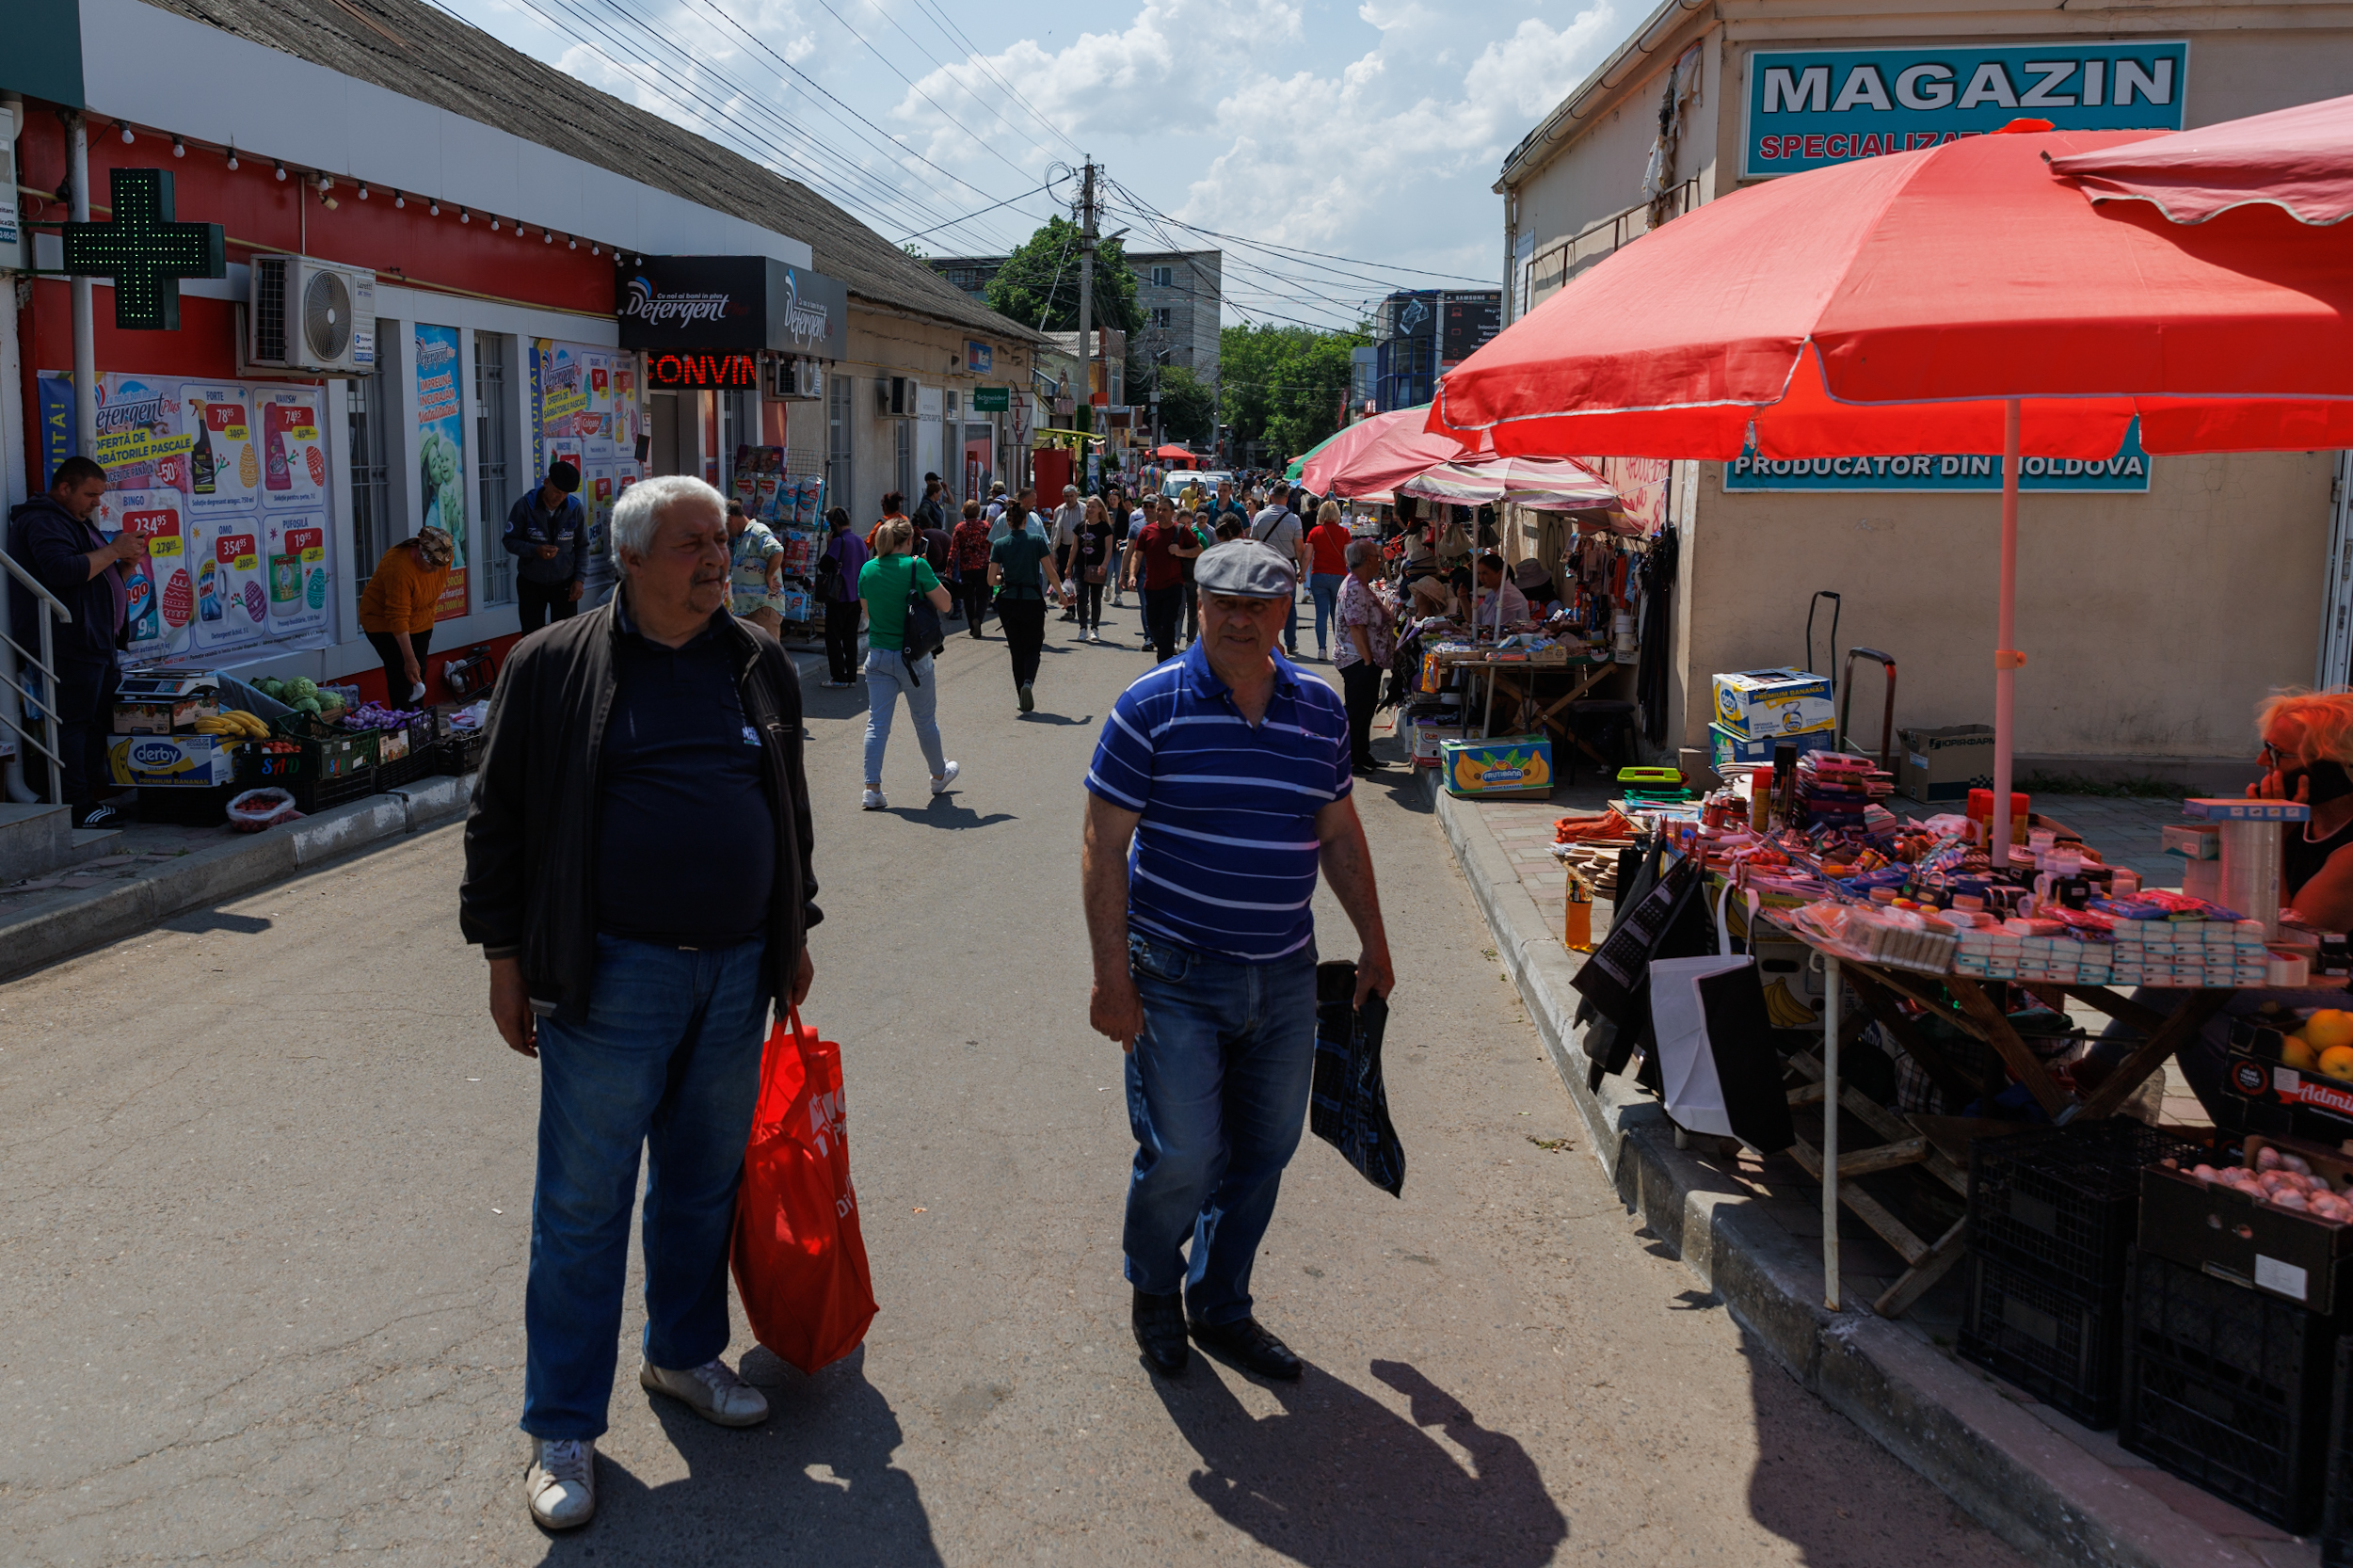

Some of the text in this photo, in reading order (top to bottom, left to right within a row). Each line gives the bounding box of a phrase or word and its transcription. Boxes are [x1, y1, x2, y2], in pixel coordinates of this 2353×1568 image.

[1761, 57, 2174, 114] MAGAZIN
[1760, 132, 1983, 159] SPECIALIZ
[626, 291, 729, 328] Detergent
[784, 291, 827, 351] Detergent
[415, 344, 449, 370] Detergent
[544, 360, 576, 387] Detergent
[648, 354, 756, 385] ONVIN
[206, 391, 224, 401] FORTE
[275, 394, 296, 404] VANISH
[548, 393, 562, 405] OFERTĂ
[976, 394, 1007, 405] Schneider
[95, 392, 182, 434] etergent Plus
[583, 419, 599, 429] Colgate
[133, 432, 146, 444] DE
[97, 438, 191, 465] RBĂTORILE PASCALE
[1734, 456, 1930, 475] PRODUCATOR
[1941, 456, 1990, 475] DIN
[123, 496, 144, 507] BINGO
[218, 525, 232, 535] OMO
[589, 523, 601, 540] DERO
[447, 570, 464, 586] social
[200, 582, 214, 598] OMO
[137, 617, 147, 636] 9
[211, 631, 232, 640] Detergent
[1753, 686, 1825, 701] PREMIUM BANANAS
[136, 744, 179, 763] derby
[262, 757, 300, 776] SAD
[329, 758, 345, 773] SAD
[1483, 770, 1522, 779] FRUTIBANA
[2297, 1083, 2353, 1112] Admi
